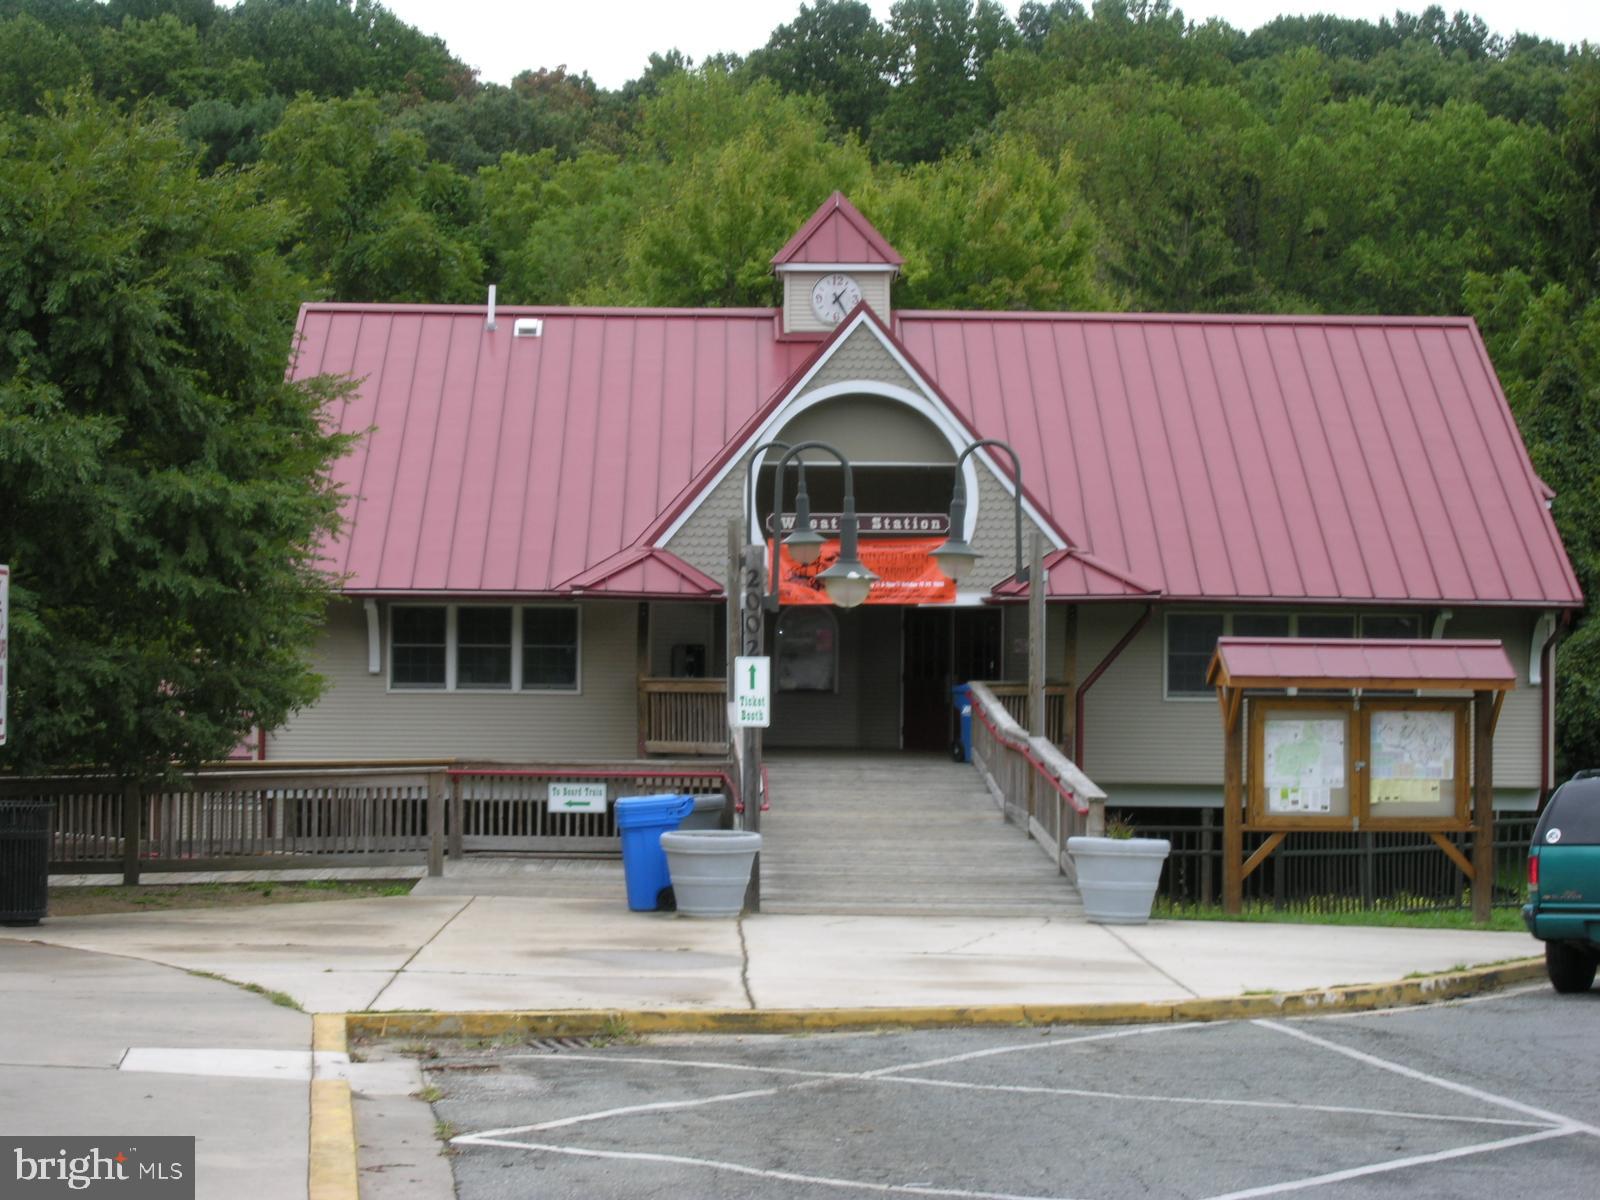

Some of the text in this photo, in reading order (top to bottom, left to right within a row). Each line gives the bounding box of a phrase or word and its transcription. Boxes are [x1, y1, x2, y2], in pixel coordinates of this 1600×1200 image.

[832, 275, 844, 286] 12
[815, 294, 823, 303] 9
[851, 294, 860, 304] 3
[833, 313, 840, 321] 6
[781, 517, 941, 530] Weat Station
[746, 570, 760, 656] 2002
[739, 695, 765, 707] Ticket
[741, 710, 764, 721] Booth
[552, 786, 603, 797] To Board Train
